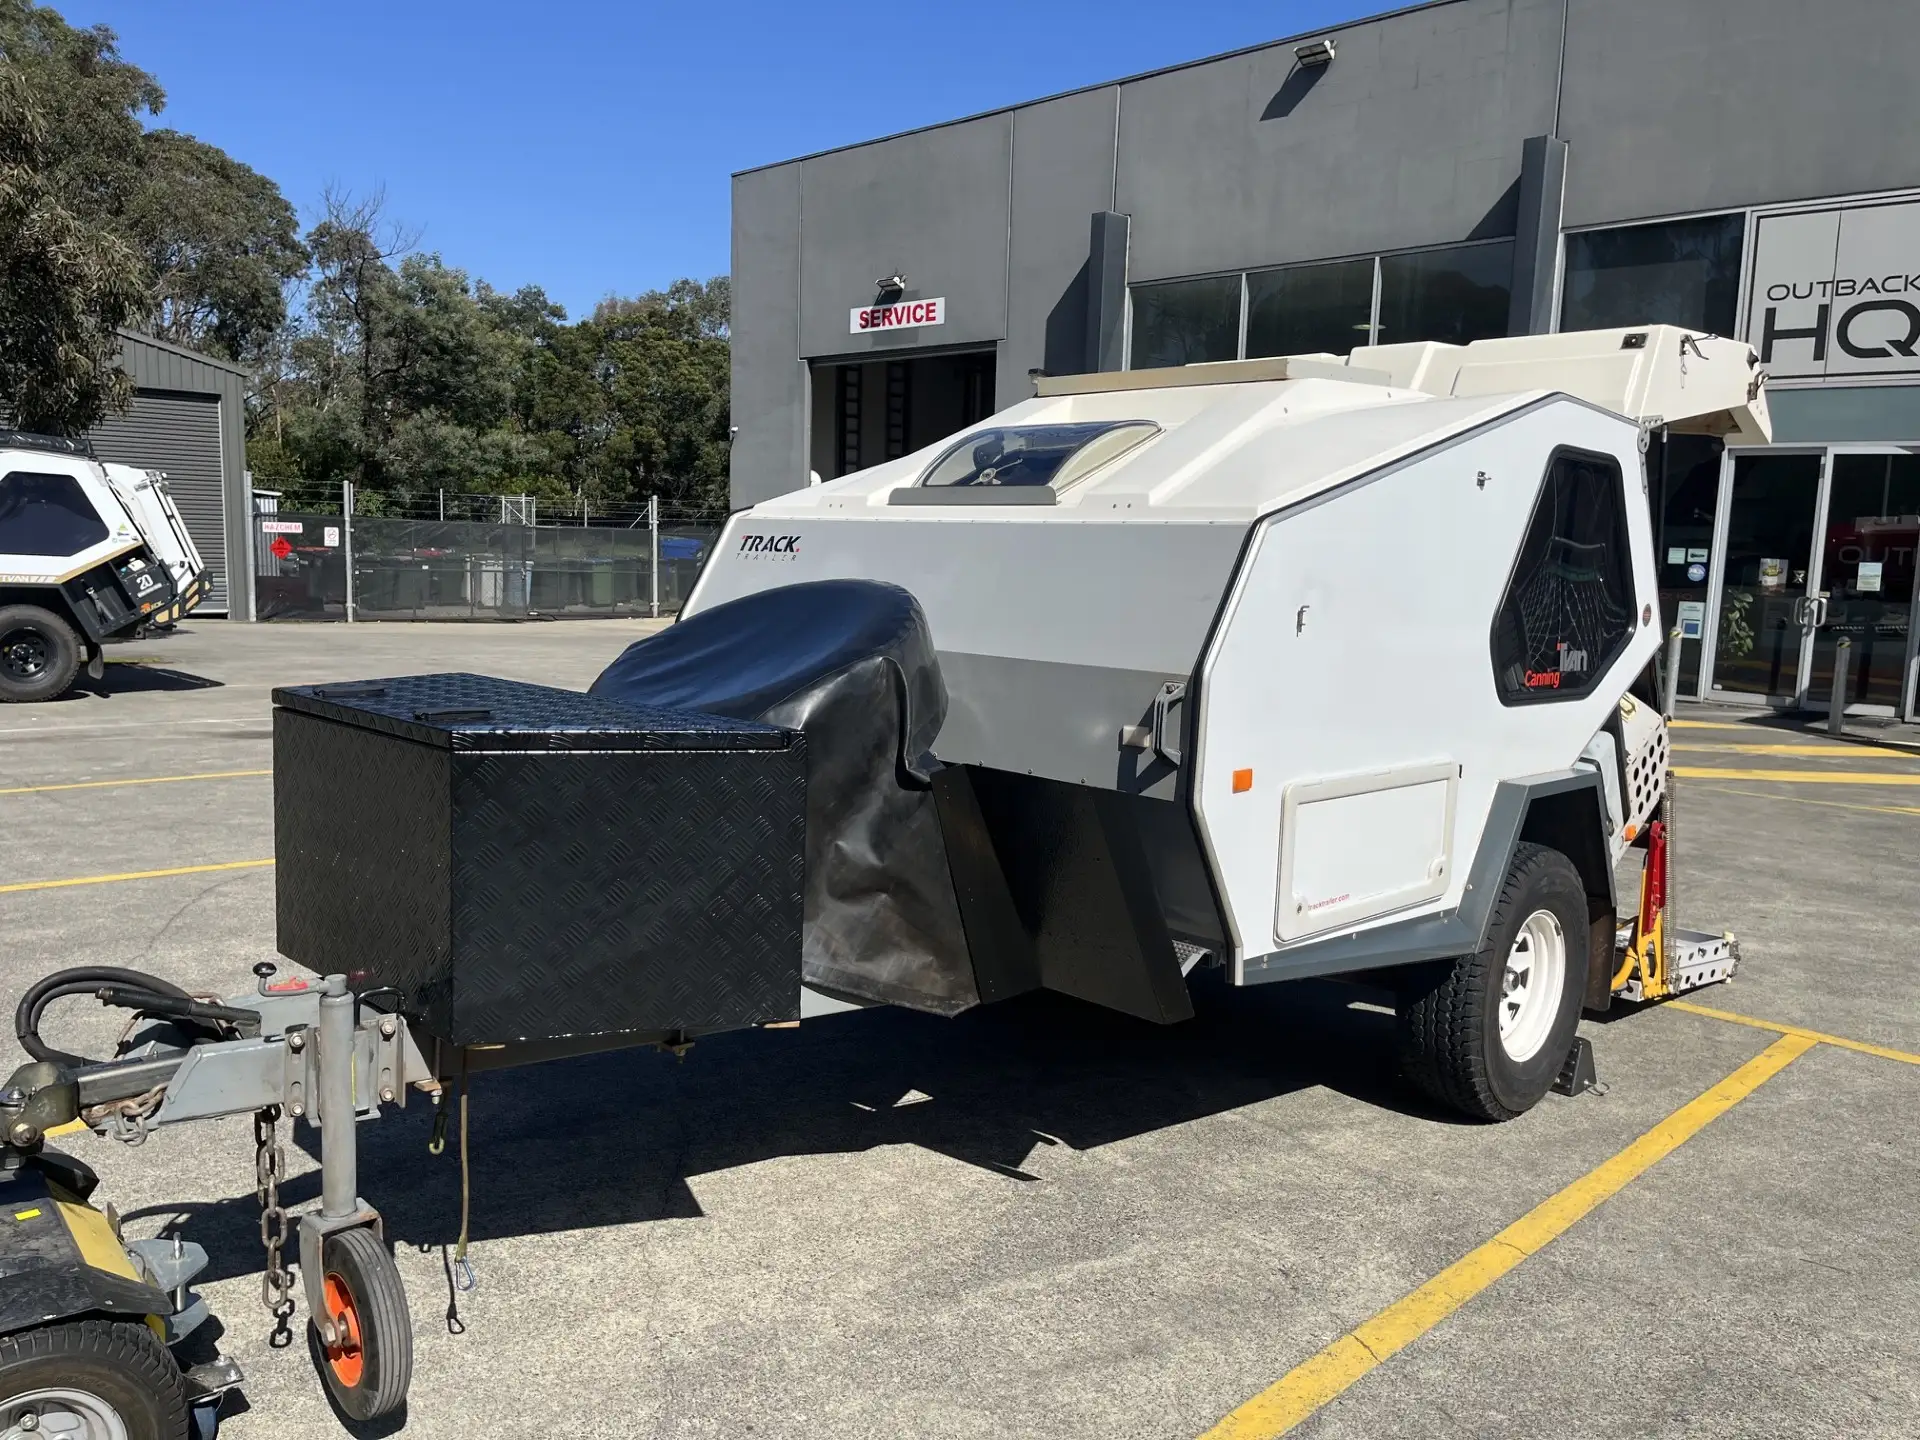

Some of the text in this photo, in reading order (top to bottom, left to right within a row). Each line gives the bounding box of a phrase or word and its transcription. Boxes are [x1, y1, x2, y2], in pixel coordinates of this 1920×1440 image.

[1767, 274, 1920, 301] OUTBACK
[859, 302, 937, 329] SERVICE
[1760, 299, 1920, 364] HQ
[264, 523, 302, 532] HAZCHEM
[735, 552, 797, 562] TRAILER
[136, 573, 154, 591] 20
[1524, 669, 1560, 689] Canning
[1307, 893, 1350, 911] tracktrailer.com
